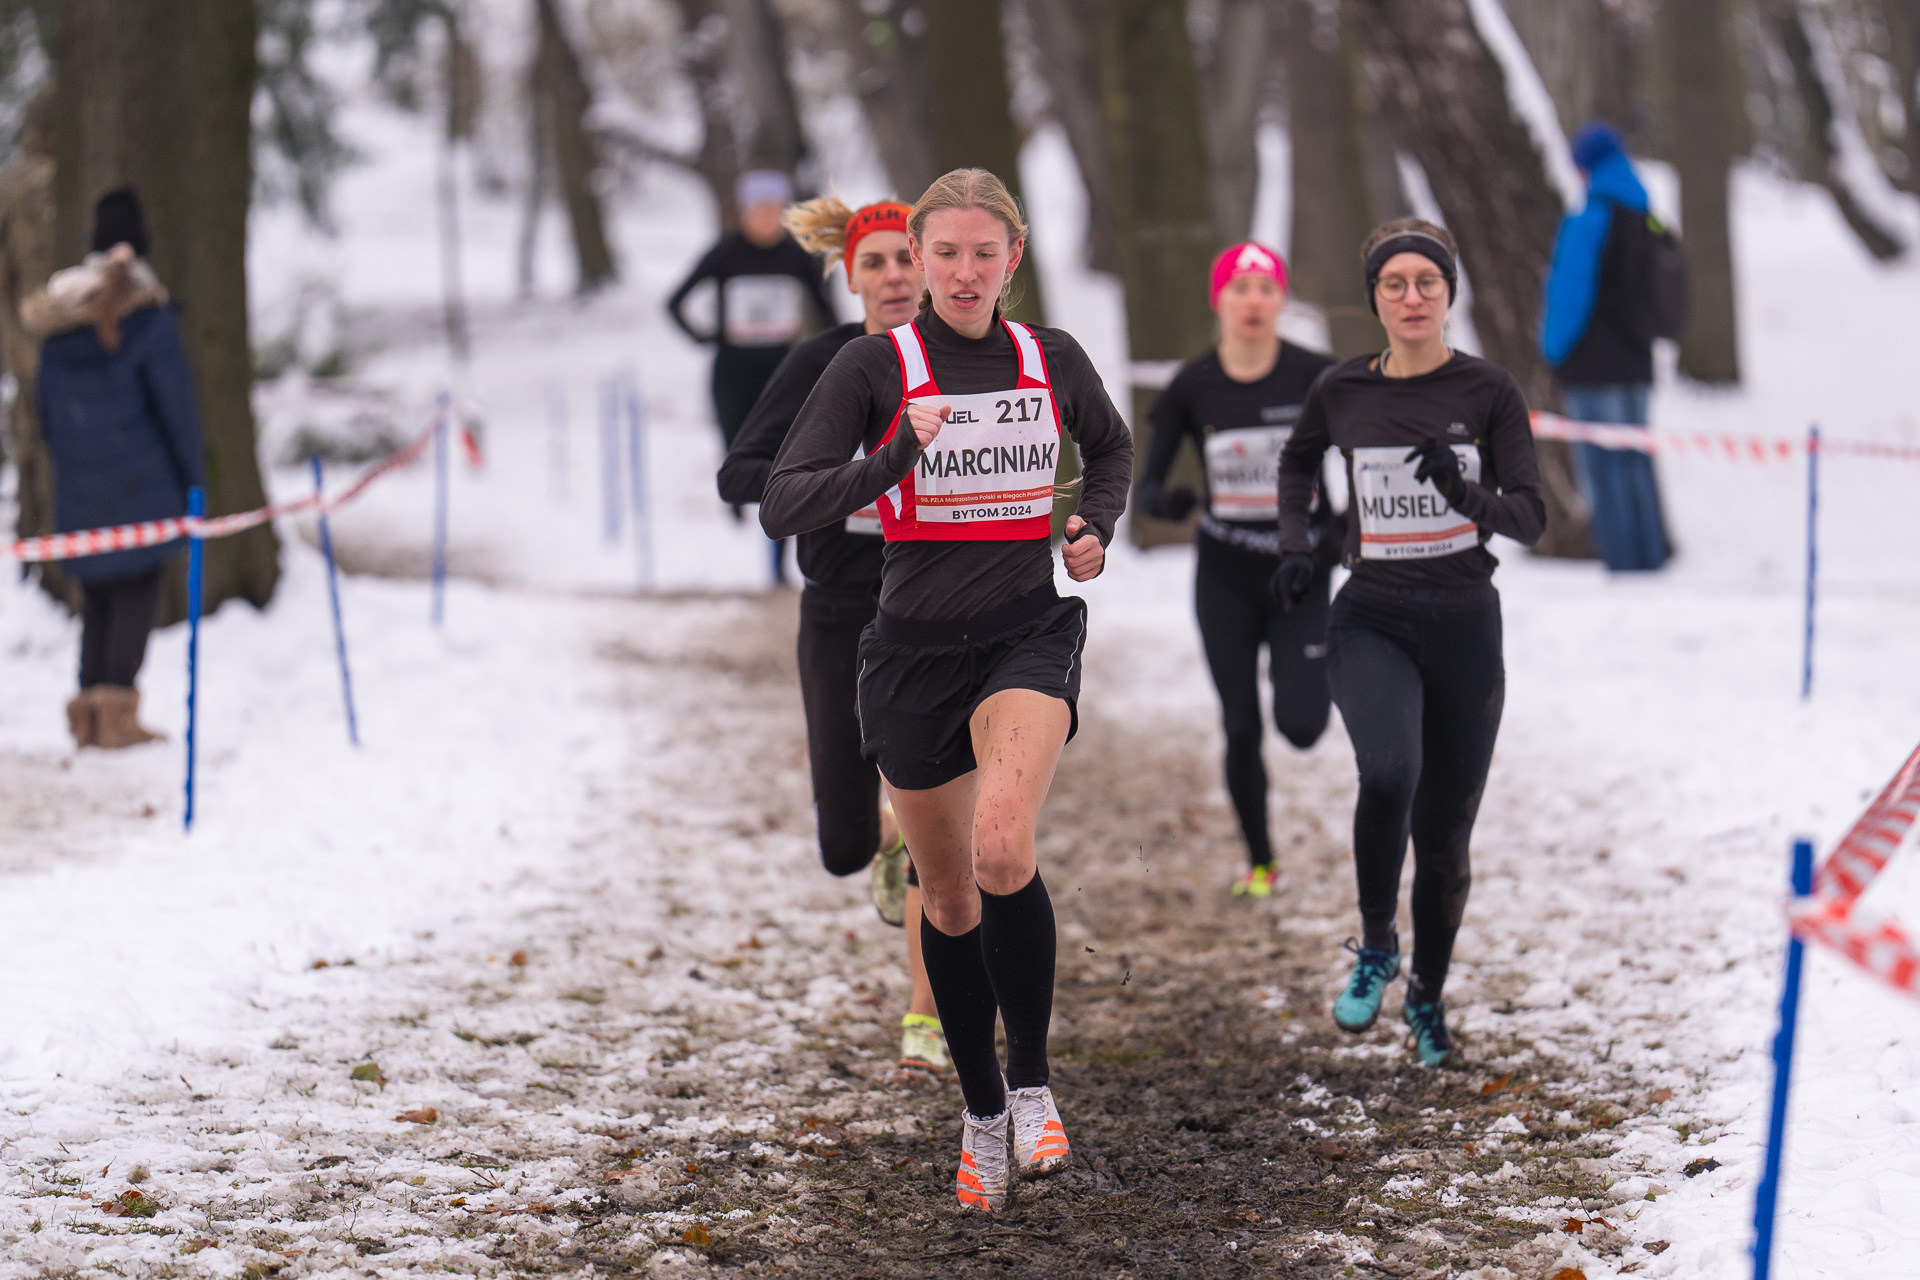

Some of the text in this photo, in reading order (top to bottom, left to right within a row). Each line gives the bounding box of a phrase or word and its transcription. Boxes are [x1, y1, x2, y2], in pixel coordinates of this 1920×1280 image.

[945, 397, 1043, 425] UEL 217
[921, 443, 1055, 479] MARCINIAK
[945, 495, 979, 503] Mistrzostwa
[979, 493, 996, 501] Polski
[1002, 492, 1027, 500] Biegach
[952, 505, 1032, 520] BYTOM 2024
[1385, 542, 1453, 556] BYTOM 2024
